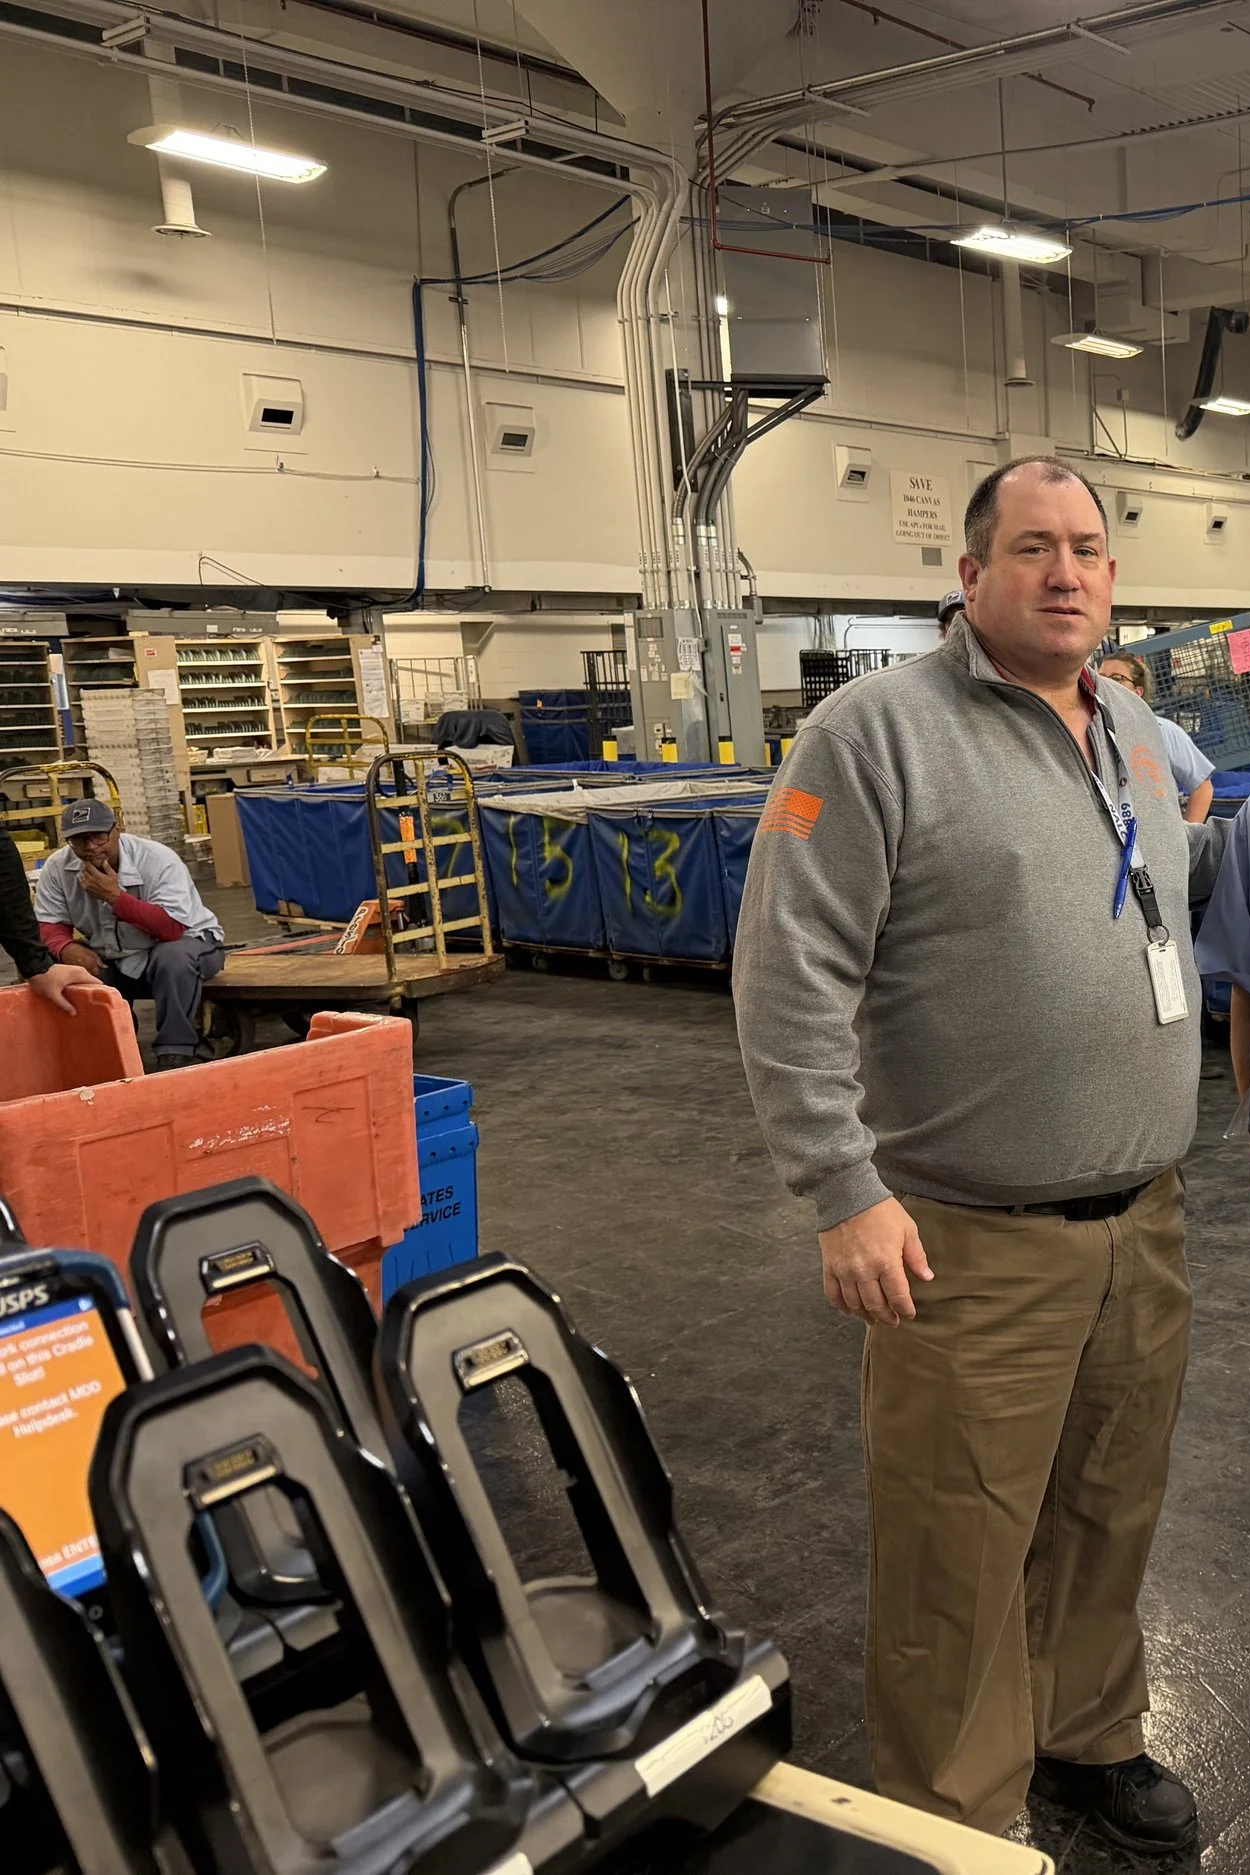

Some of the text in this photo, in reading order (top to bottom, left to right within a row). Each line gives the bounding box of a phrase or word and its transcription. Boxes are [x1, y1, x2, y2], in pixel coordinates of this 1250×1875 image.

[910, 477, 932, 491] SAVE
[908, 508, 938, 519] HAMPERS
[916, 495, 941, 506] CANVAS
[896, 530, 913, 538] GOING
[1109, 804, 1127, 839] NALC
[508, 814, 573, 901] 15
[617, 829, 683, 917] 13
[336, 908, 367, 954] Presto
[421, 1185, 454, 1207] ATES
[404, 1201, 462, 1232] RVICE
